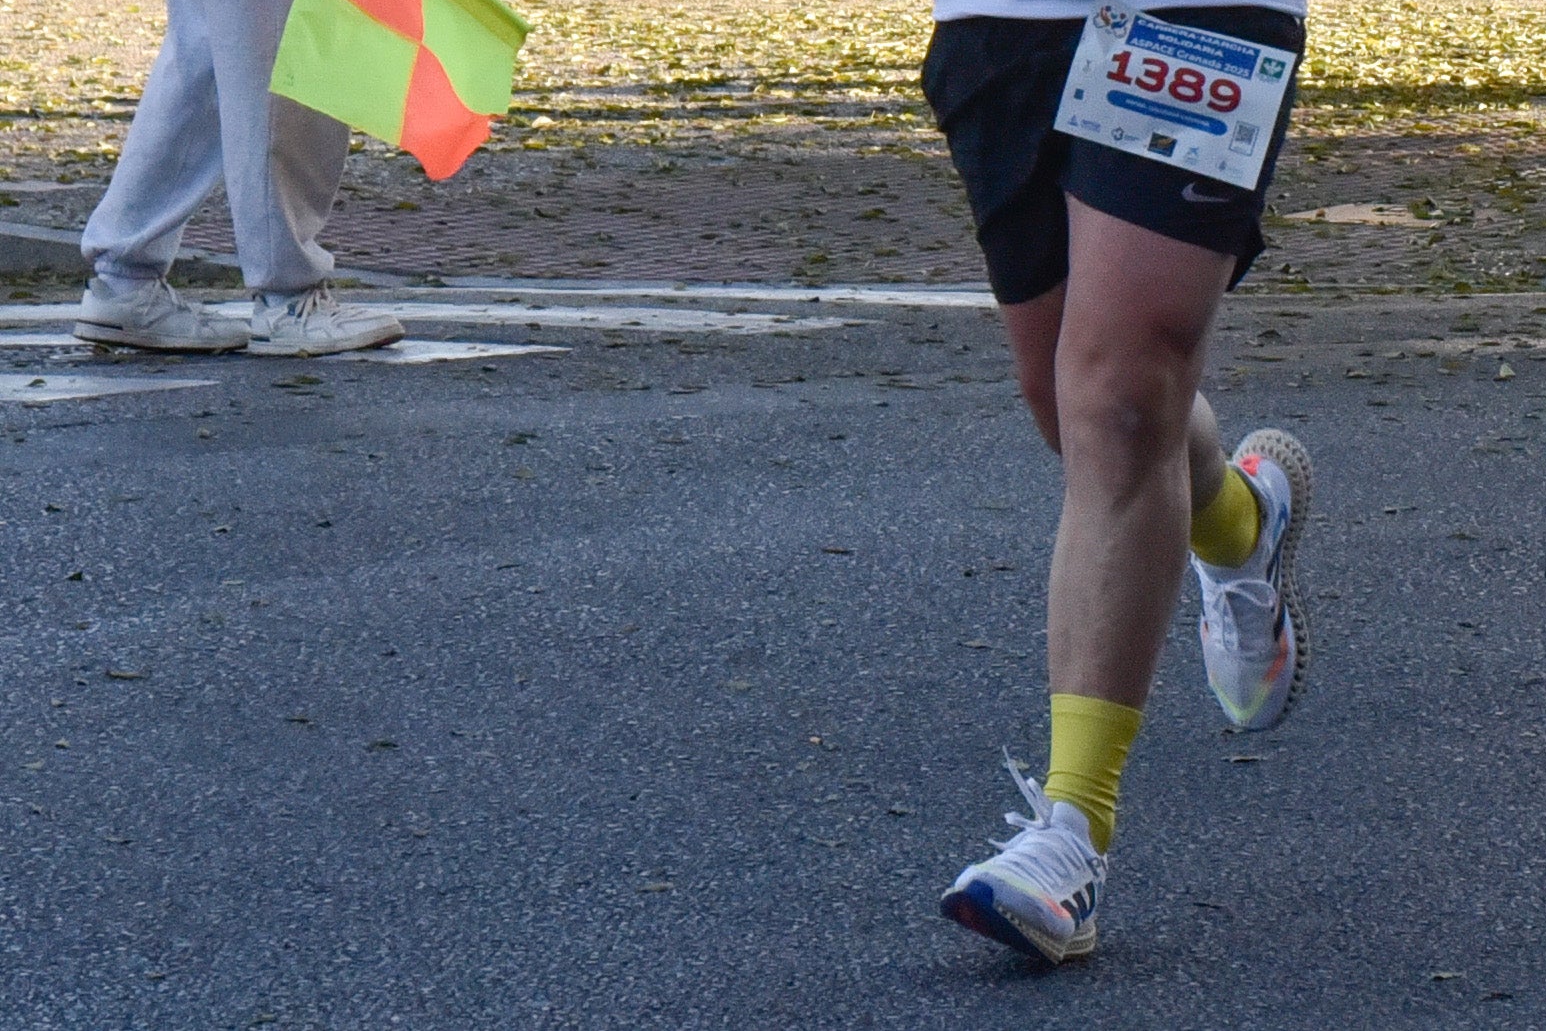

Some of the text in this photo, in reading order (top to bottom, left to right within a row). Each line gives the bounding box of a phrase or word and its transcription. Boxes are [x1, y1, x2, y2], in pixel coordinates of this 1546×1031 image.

[1137, 19, 1256, 57] CARRERA-MARCHA
[1157, 33, 1224, 58] SOLIDARIA
[1129, 38, 1176, 57] ASPACE
[1176, 49, 1222, 69] Granada
[1224, 62, 1250, 77] 2025
[1106, 50, 1242, 113] 1389
